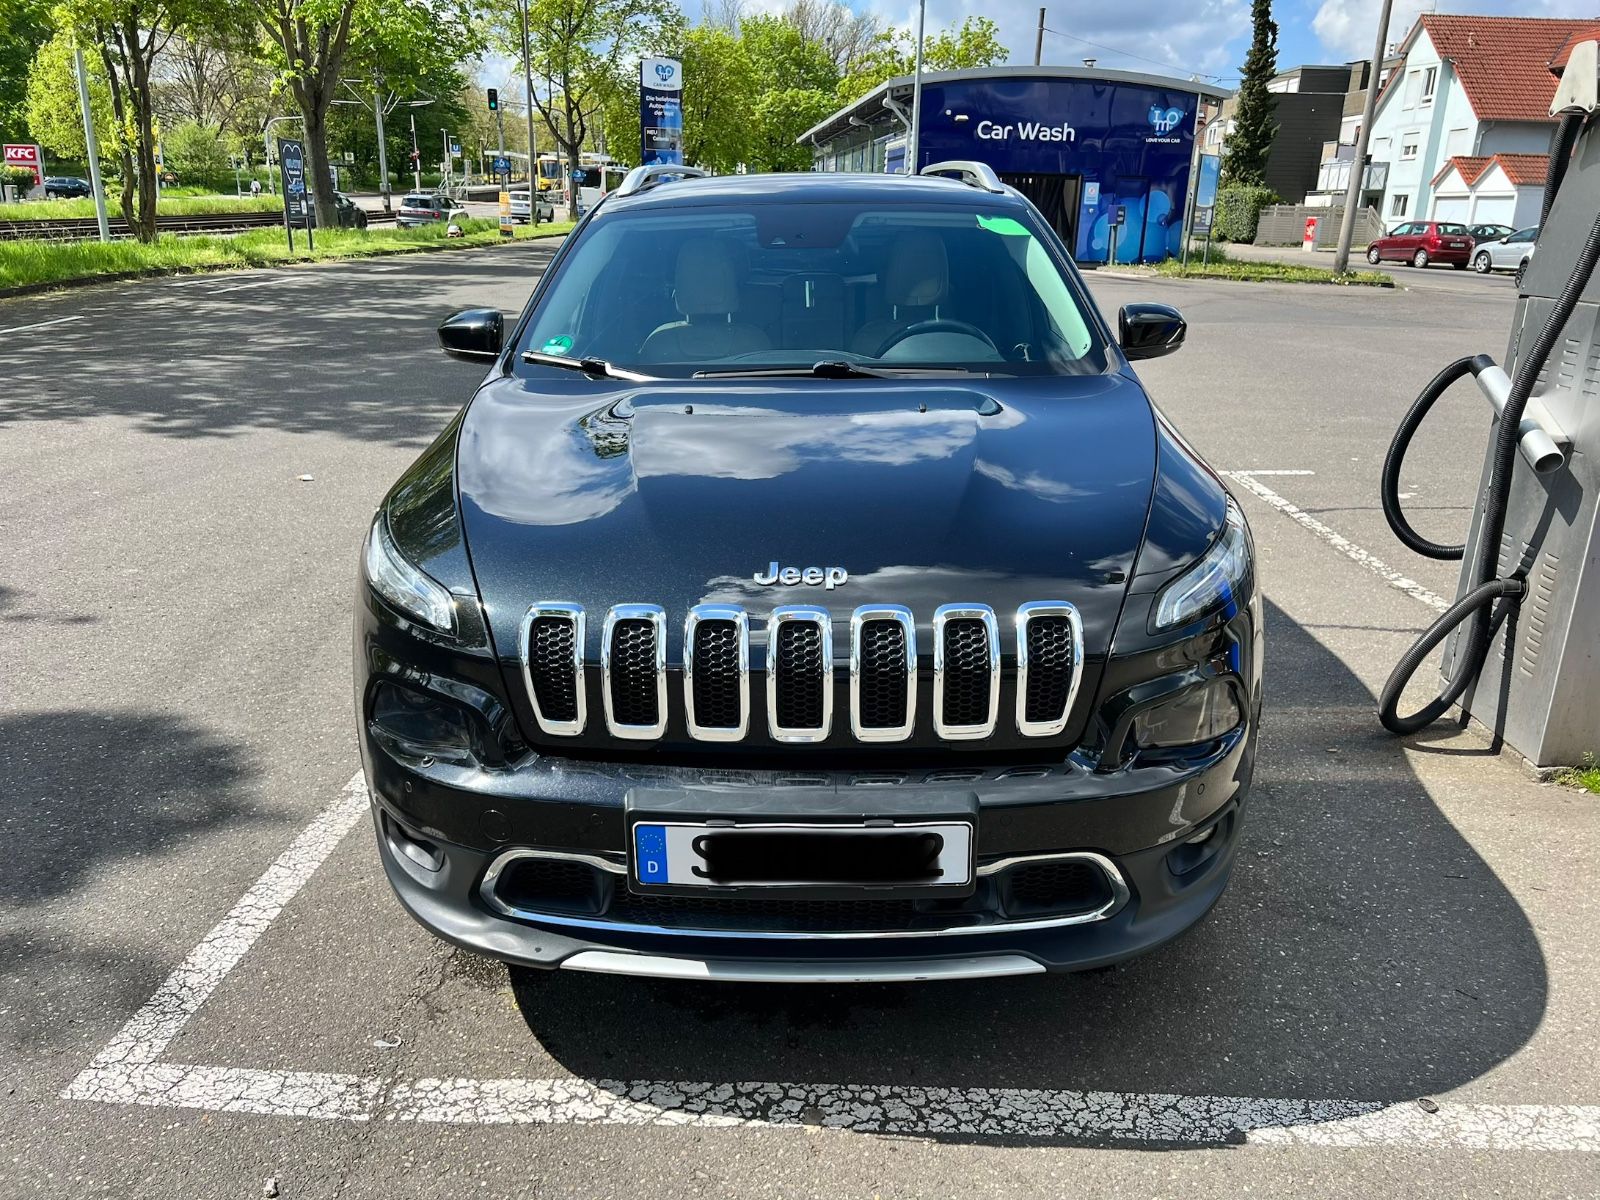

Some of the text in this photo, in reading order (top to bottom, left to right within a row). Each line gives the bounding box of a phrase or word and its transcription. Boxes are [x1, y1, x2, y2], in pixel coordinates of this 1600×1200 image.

[977, 120, 1076, 142] Car Wash
[6, 147, 34, 158] KFC
[499, 158, 505, 168] 6
[753, 561, 849, 591] Jeep
[647, 860, 659, 873] D
